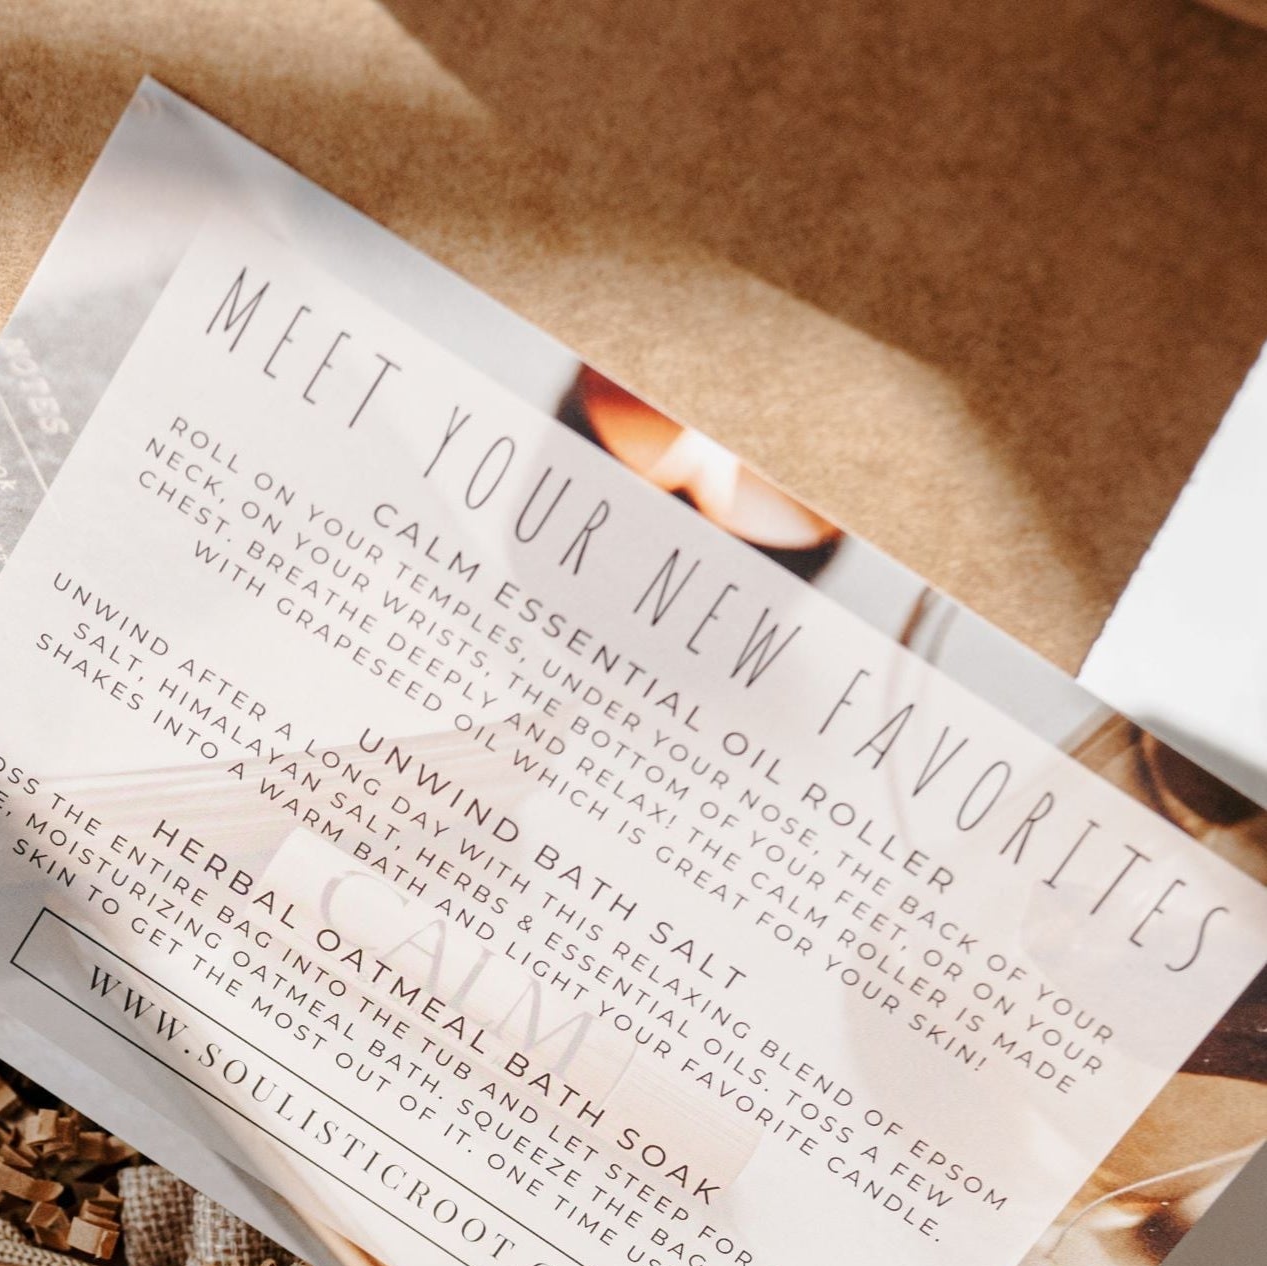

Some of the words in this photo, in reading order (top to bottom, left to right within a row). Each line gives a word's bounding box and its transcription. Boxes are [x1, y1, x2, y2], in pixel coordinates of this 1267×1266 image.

[52, 571, 169, 656] UNWIND
[176, 657, 267, 722] AFTER
[273, 721, 292, 741] A
[303, 737, 382, 797] LONG
[389, 794, 450, 838] DAY
[458, 836, 531, 895] WITH
[541, 890, 604, 942] THIS
[610, 939, 751, 1040] RELAXING
[758, 1038, 853, 1107] BLEND
[863, 1108, 904, 1136] OF
[908, 1138, 1008, 1211] EPSOM
[137, 469, 231, 543] CHEST.
[245, 539, 377, 634] BREATHE
[385, 631, 498, 709] DEEPLY
[502, 711, 566, 756] AND
[574, 755, 677, 829] RELAX!
[686, 825, 741, 872] THE
[749, 870, 829, 929] CALM
[836, 927, 947, 1009] ROLLER
[954, 1006, 985, 1033] IS
[991, 1031, 1076, 1094] MADE
[169, 415, 238, 474] ROLL
[253, 471, 296, 506] ON
[307, 502, 383, 564] YOUR
[395, 561, 525, 663] TEMPLES,
[541, 658, 641, 732] UNDER
[652, 728, 730, 790] YOUR
[738, 787, 819, 855] NOSE,
[836, 850, 891, 896] THE
[898, 894, 978, 954] BACK
[986, 953, 1027, 981] OF
[1036, 982, 1113, 1044] YOUR
[193, 538, 266, 598] WITH
[275, 596, 443, 712] GRAPESEED
[453, 712, 496, 752] OIL
[512, 747, 609, 821] WHICH
[616, 818, 646, 845] IS
[654, 844, 749, 910] GREAT
[754, 910, 813, 957] FOR
[824, 953, 900, 1015] YOUR
[907, 1012, 987, 1072] SKIN!
[204, 265, 401, 429] MEET
[422, 405, 610, 576] YOUR
[631, 546, 802, 689] NEW
[817, 667, 1229, 973] FAVORITES
[357, 726, 520, 843] UNWIND
[532, 843, 638, 922] BATH
[647, 920, 747, 989] SALT
[372, 502, 481, 583] CALM
[493, 580, 700, 733] ESSENTIAL
[721, 730, 781, 785] OIL
[799, 781, 954, 894] ROLLER
[24, 811, 222, 950] MOISTURIZING
[231, 949, 354, 1042] OATMEAL
[366, 1037, 443, 1100] BATH.
[455, 1097, 582, 1188] SQUEEZE
[590, 1183, 643, 1229] THE
[34, 632, 144, 711] SHAKES
[151, 708, 219, 760] INTO
[225, 760, 245, 781] A
[258, 775, 345, 843] WARM
[351, 840, 428, 898] BATH
[433, 897, 495, 941] AND
[504, 940, 590, 1000] LIGHT
[597, 998, 672, 1059] YOUR
[679, 1056, 819, 1157] FAVORITE
[826, 1155, 940, 1243] CANDLE.
[50, 791, 102, 837] THE
[108, 833, 209, 907] ENTIRE
[215, 903, 274, 949] BAG
[280, 946, 347, 997] INTO
[358, 994, 411, 1040] THE
[419, 1035, 472, 1080] TUB
[477, 1081, 539, 1124] AND
[547, 1123, 600, 1162] LET
[603, 1162, 690, 1221] STEEP
[72, 621, 144, 682] SALT,
[157, 676, 322, 793] HIMALAYAN
[328, 790, 401, 852] SALT,
[414, 845, 509, 915] HERBS
[515, 913, 534, 934] &
[543, 930, 689, 1039] ESSENTIAL
[702, 1036, 769, 1092] OILS.
[784, 1087, 854, 1144] TOSS
[858, 1144, 879, 1164] A
[888, 1160, 954, 1208] FEW
[151, 817, 295, 930] HERBAL
[315, 927, 485, 1055] OATMEAL
[502, 1050, 606, 1128] BATH
[615, 1126, 722, 1206] SOAK
